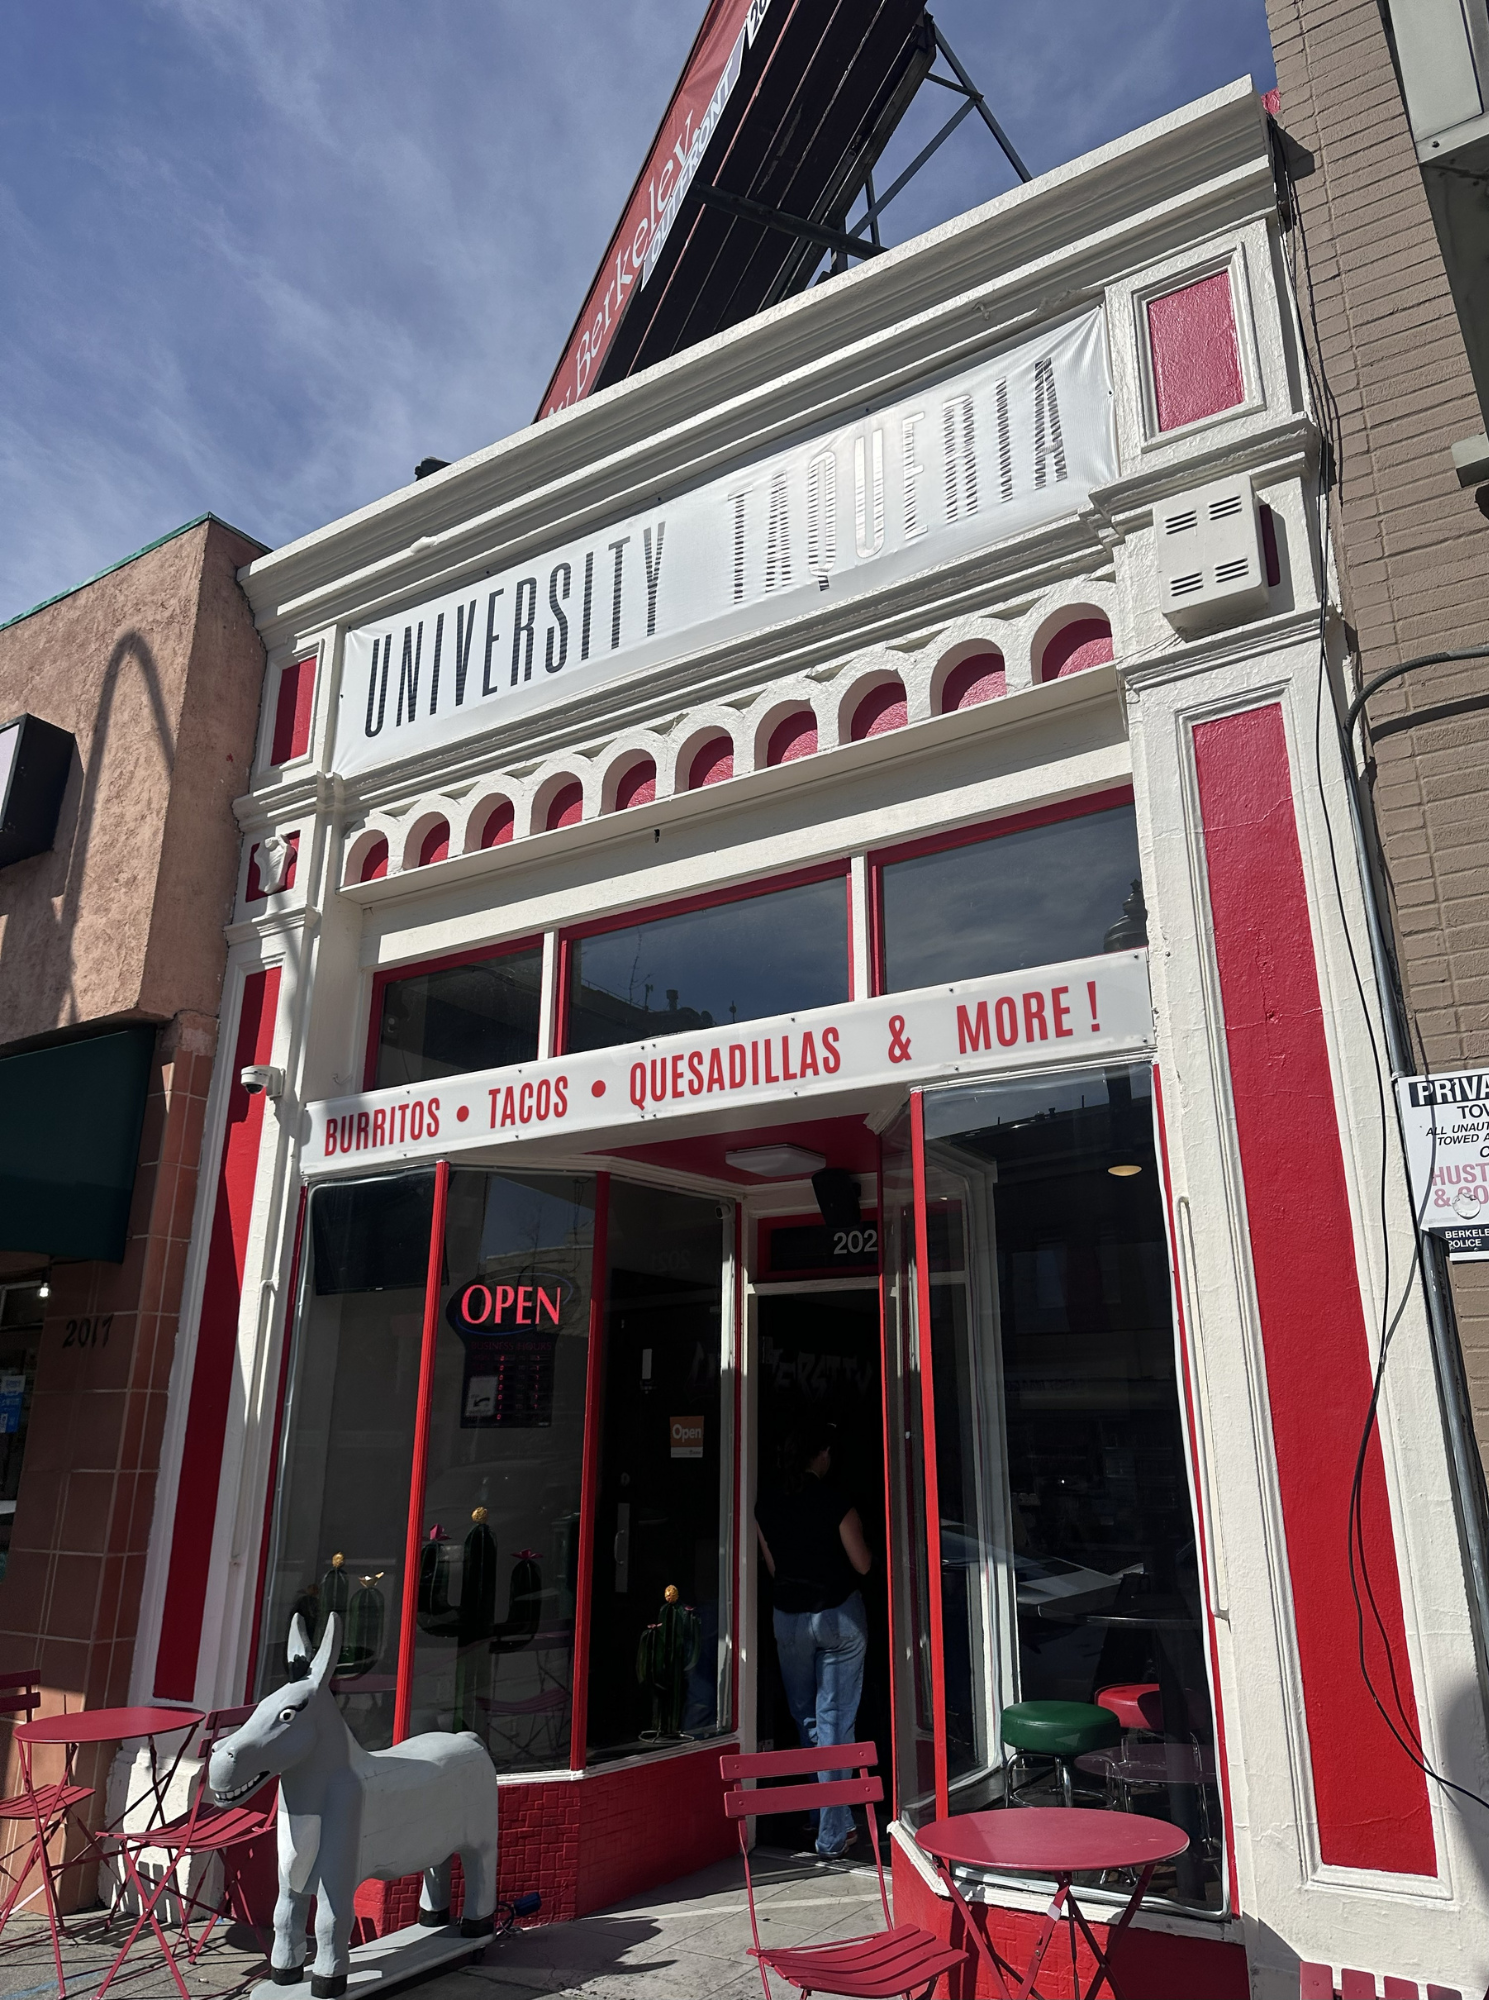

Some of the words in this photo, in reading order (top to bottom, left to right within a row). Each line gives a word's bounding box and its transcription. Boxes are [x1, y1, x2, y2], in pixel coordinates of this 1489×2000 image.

[651, 56, 734, 258] OUTFRONT
[364, 520, 666, 738] UNIVERSITY
[727, 357, 1069, 604] TAQUERIA
[324, 1097, 440, 1157] BURRITOS
[488, 1075, 569, 1129] TACOS
[629, 1026, 841, 1111] QUESADILLAS
[888, 1014, 912, 1064] &
[1425, 1126, 1447, 1137] ALL
[1437, 1133, 1480, 1146] TOWED
[1433, 1188, 1451, 1208] &
[460, 1284, 561, 1326] OPEN
[672, 1423, 702, 1443] Open
